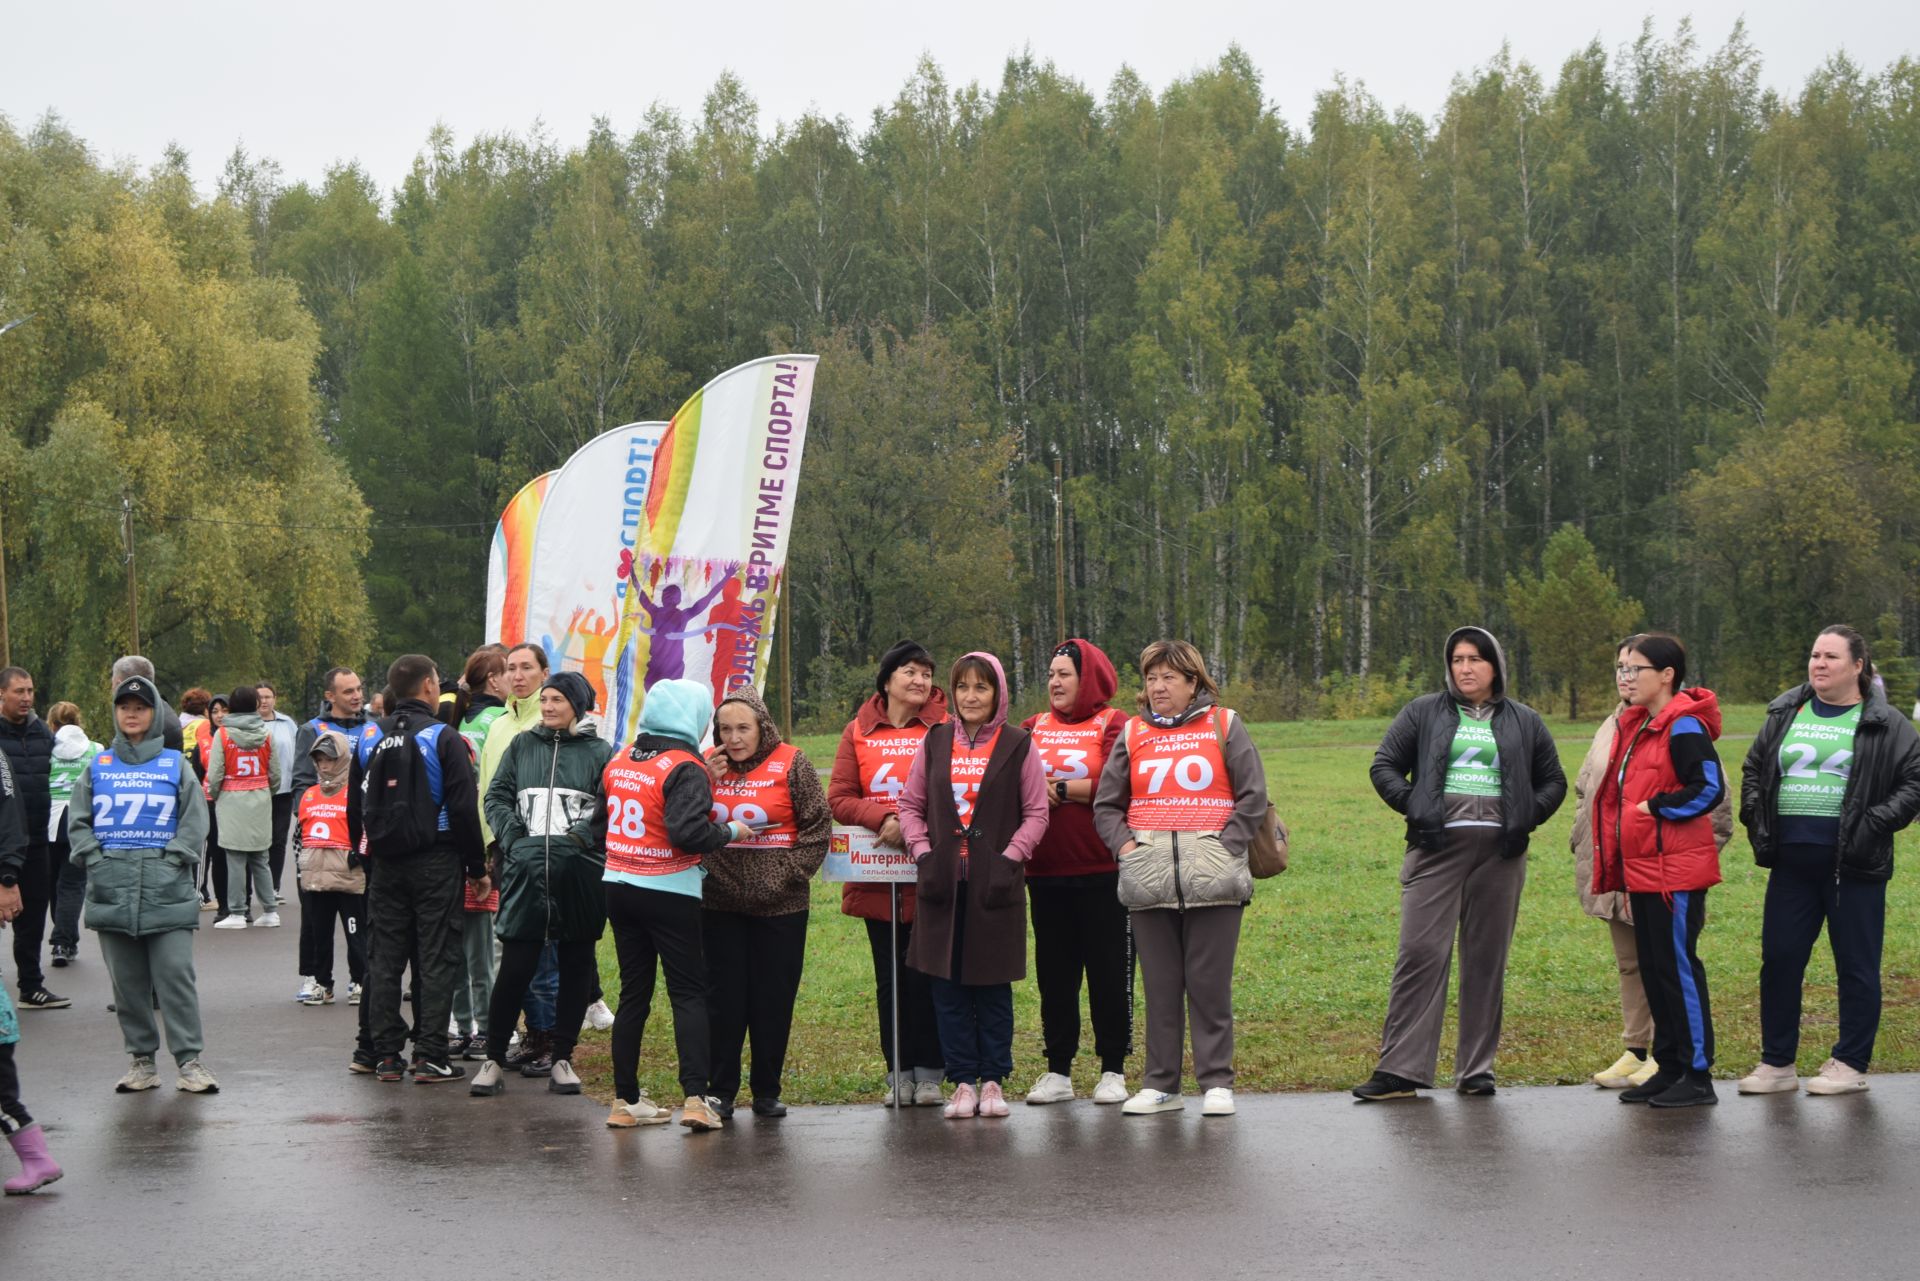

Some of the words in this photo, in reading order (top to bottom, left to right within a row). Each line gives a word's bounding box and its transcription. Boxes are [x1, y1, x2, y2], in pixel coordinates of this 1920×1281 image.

[762, 363, 799, 471] СПОРТА!
[749, 477, 785, 567] РИТМЕ
[728, 598, 767, 693] ОДЕЖЬ
[1041, 736, 1079, 745] РАЙОН
[1794, 730, 1839, 741] РАЙОН
[1154, 741, 1199, 753] РАЙОН
[237, 755, 260, 777] 51
[100, 771, 169, 781] ТУКАЕВСКИЙ
[1138, 754, 1214, 795] 70
[113, 779, 153, 789] РАЙОН
[613, 779, 641, 793] РАЙОН
[1787, 783, 1830, 795] НОРМА
[1155, 796, 1198, 806] НОРМА
[92, 793, 176, 827] 277
[607, 795, 646, 839] 28
[113, 830, 151, 839] НОРМА
[634, 846, 673, 858] ЖИЗНИ
[862, 868, 899, 876] сельское
